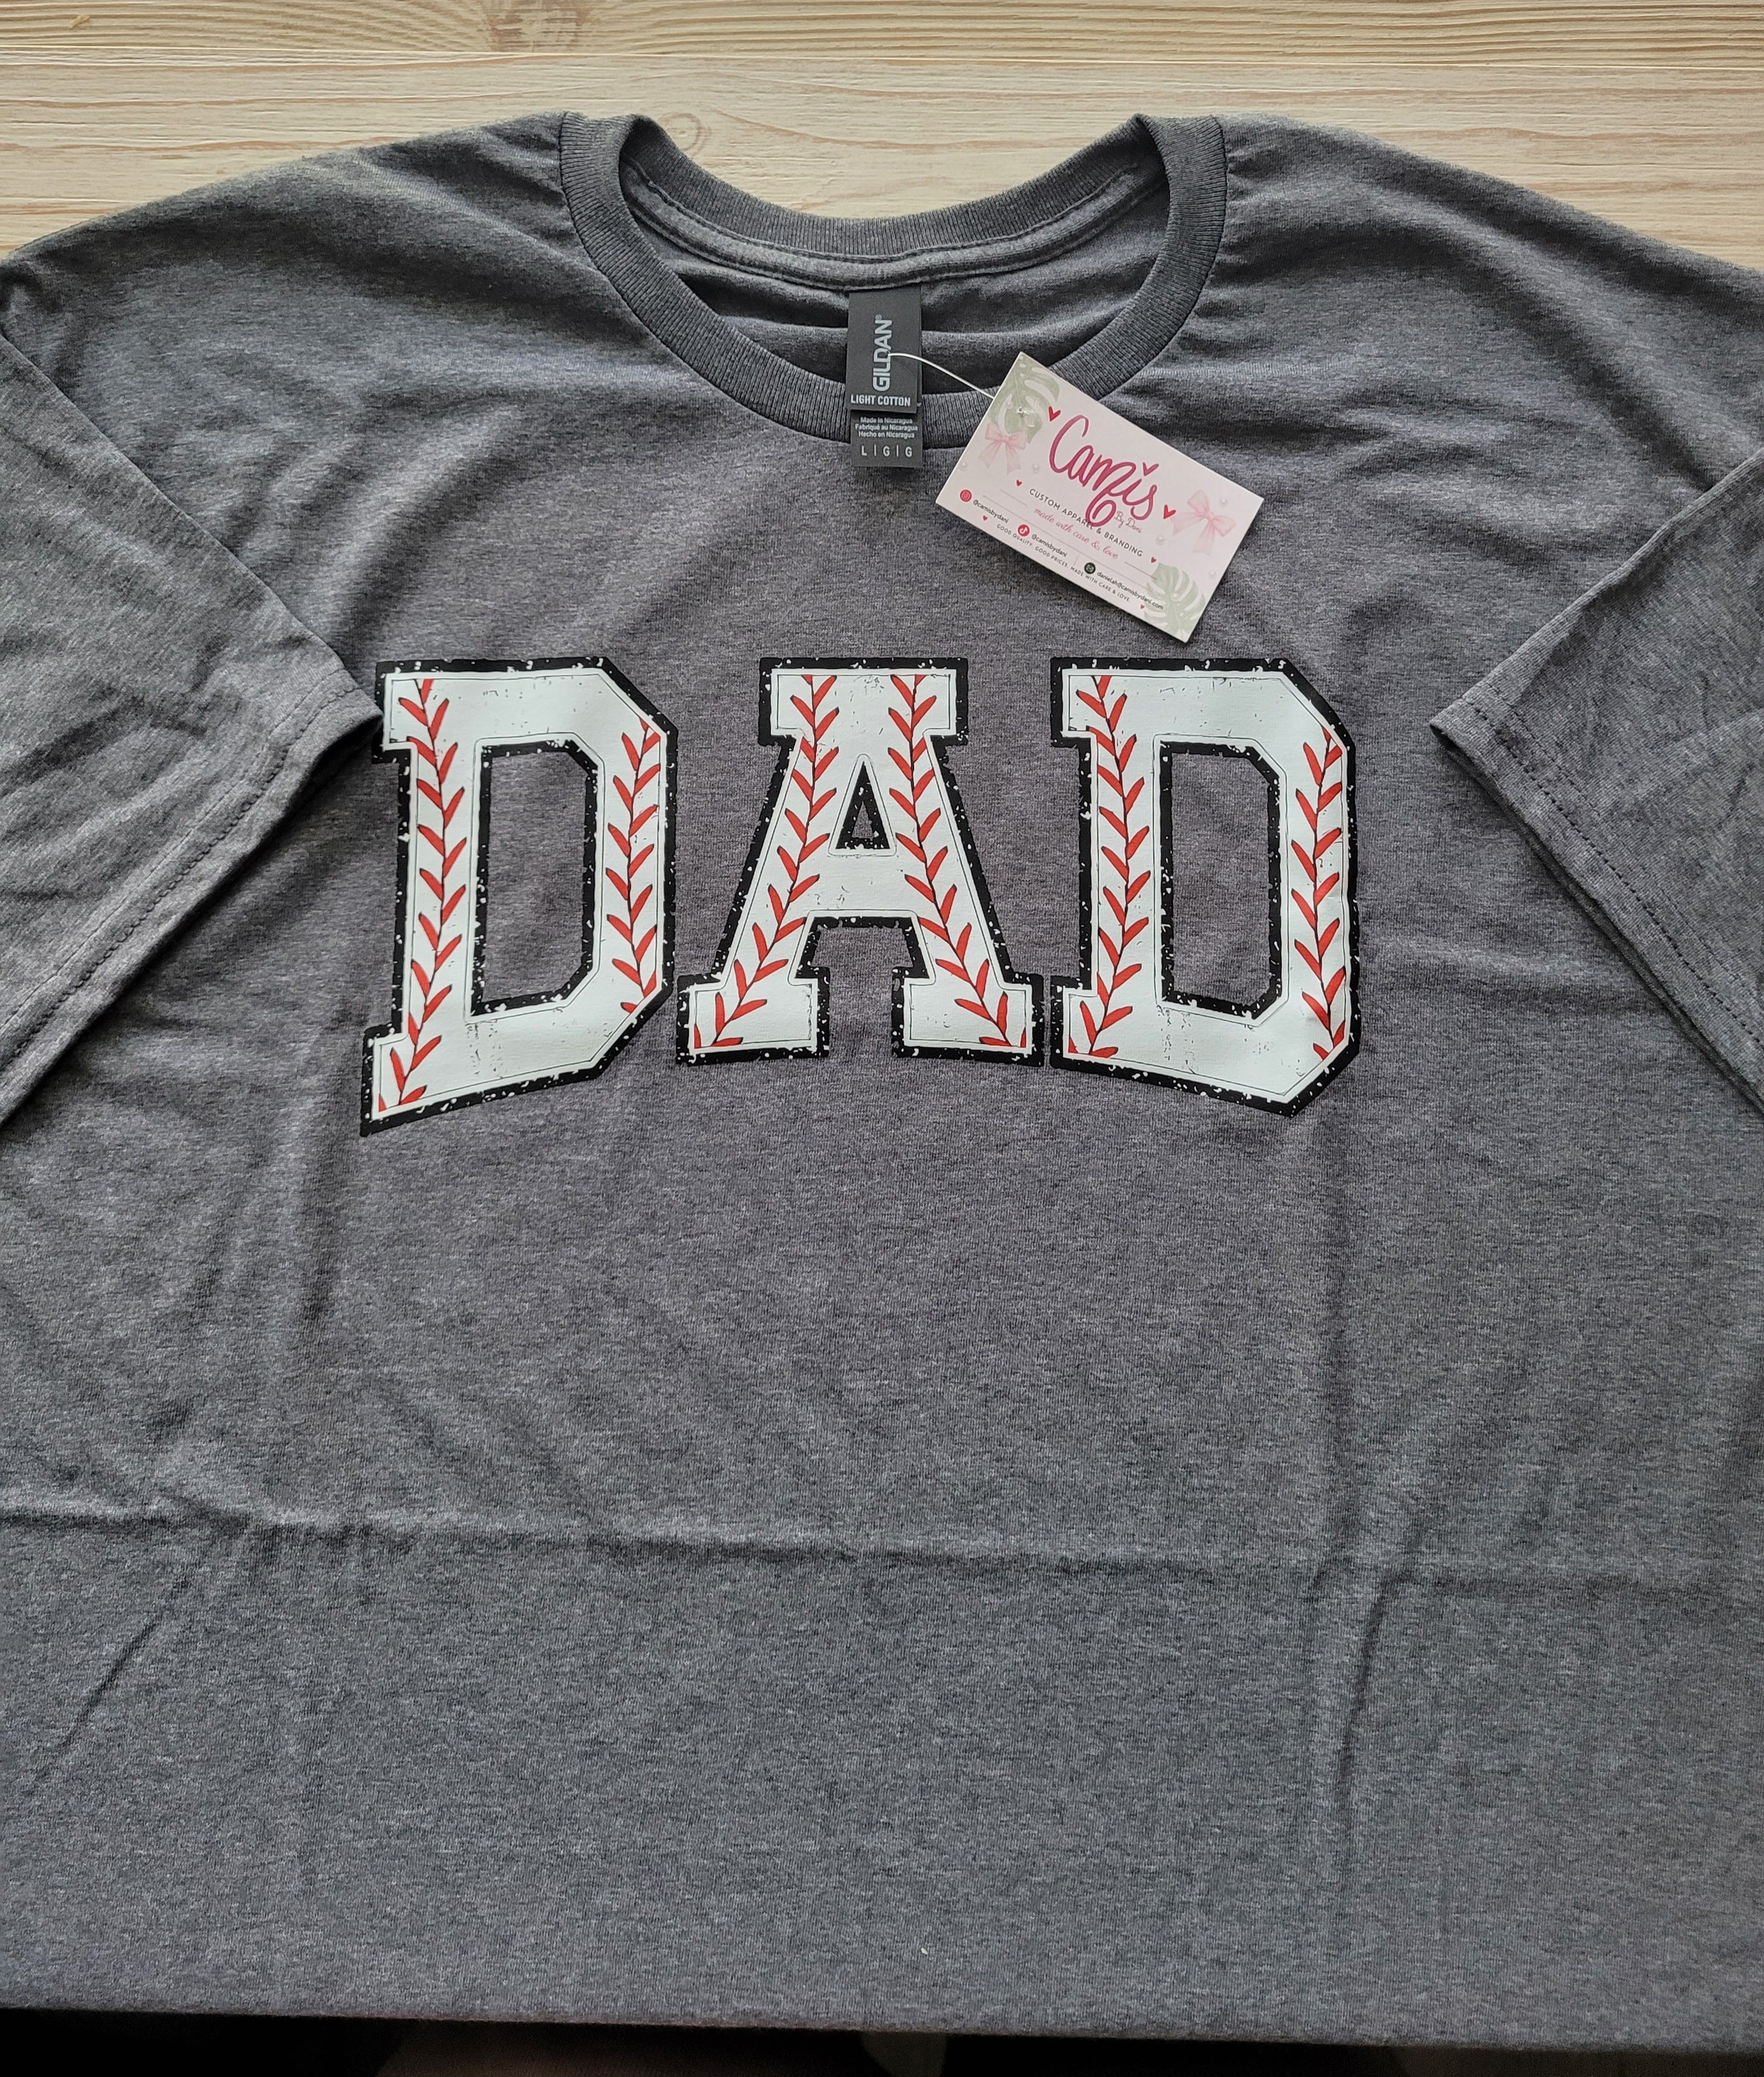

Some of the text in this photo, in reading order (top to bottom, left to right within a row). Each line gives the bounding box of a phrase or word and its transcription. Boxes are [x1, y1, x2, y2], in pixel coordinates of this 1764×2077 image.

[850, 394, 876, 405] LIGHT
[877, 395, 911, 407] COTTON
[886, 432, 915, 440] Nicaragua
[972, 499, 1009, 524] @camisbydani
[1029, 488, 1061, 510] CUSTOM
[1062, 508, 1093, 530] APPAREL
[1104, 531, 1144, 557] BRANDING
[1114, 511, 1124, 528] By
[1031, 534, 1068, 558] @camisbydani
[1033, 508, 1118, 559] made with care & love
[996, 524, 1012, 535] GOOD
[1035, 546, 1050, 558] GOOD
[1070, 566, 1084, 577] MADE
[1085, 575, 1098, 584] WITH
[1098, 582, 1111, 592] CARE
[360, 657, 1359, 1134] DAD
